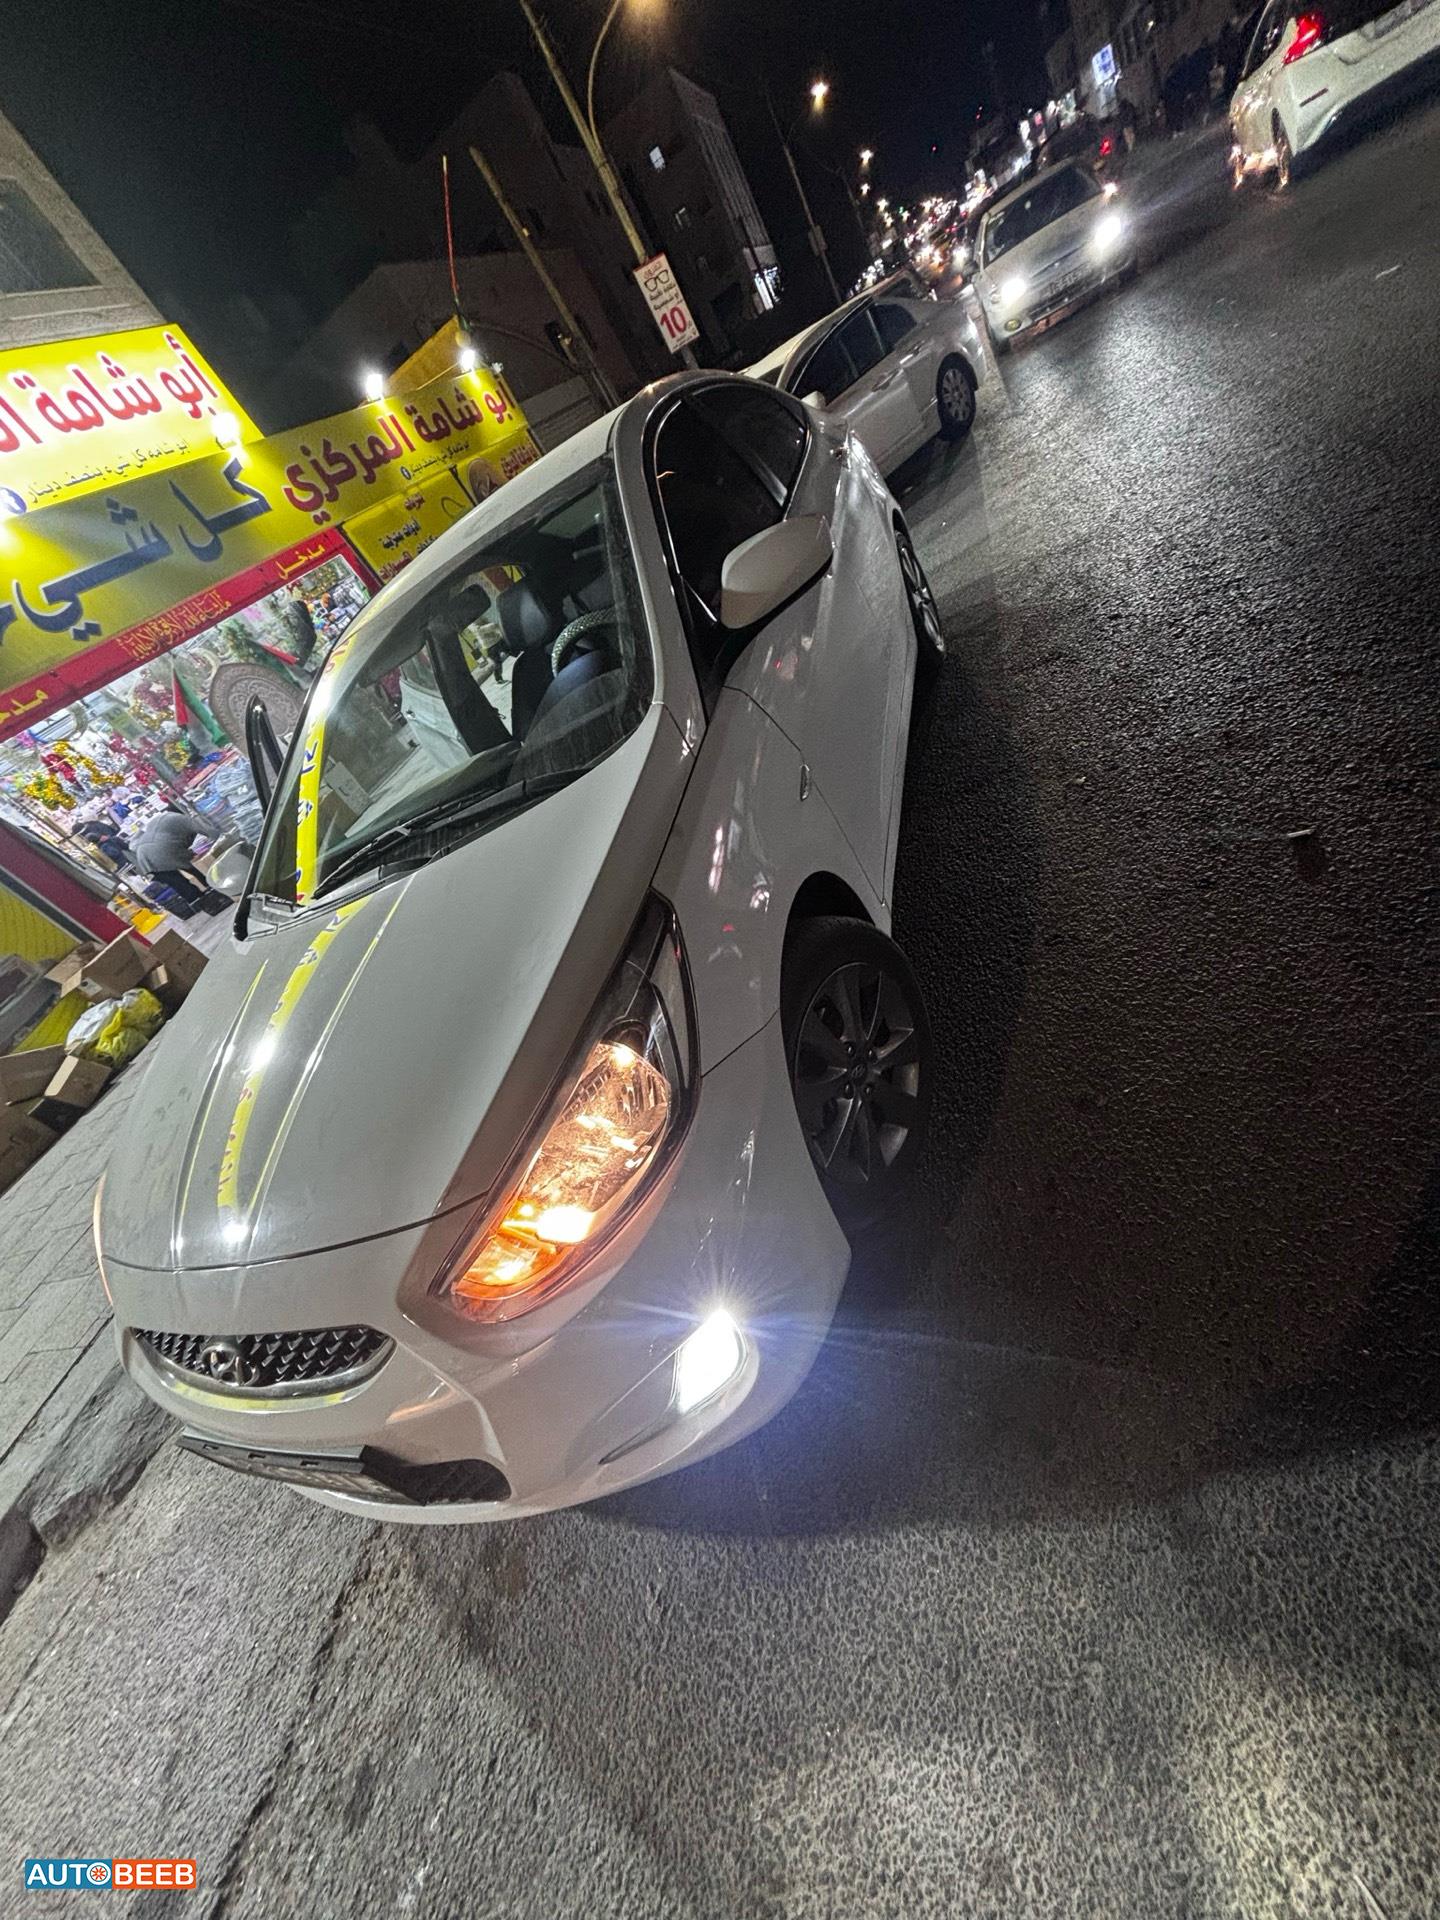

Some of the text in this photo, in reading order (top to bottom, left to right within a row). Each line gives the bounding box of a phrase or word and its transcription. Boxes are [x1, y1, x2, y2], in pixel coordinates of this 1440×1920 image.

[660, 306, 687, 338] 10
[13, 354, 162, 433] شامة
[160, 333, 218, 419] أبو
[404, 387, 484, 443] شامة
[133, 449, 148, 468] كل
[283, 414, 416, 525] المركزي
[28, 481, 62, 504] دينار
[169, 457, 272, 562] كل
[273, 544, 326, 580] مدخل
